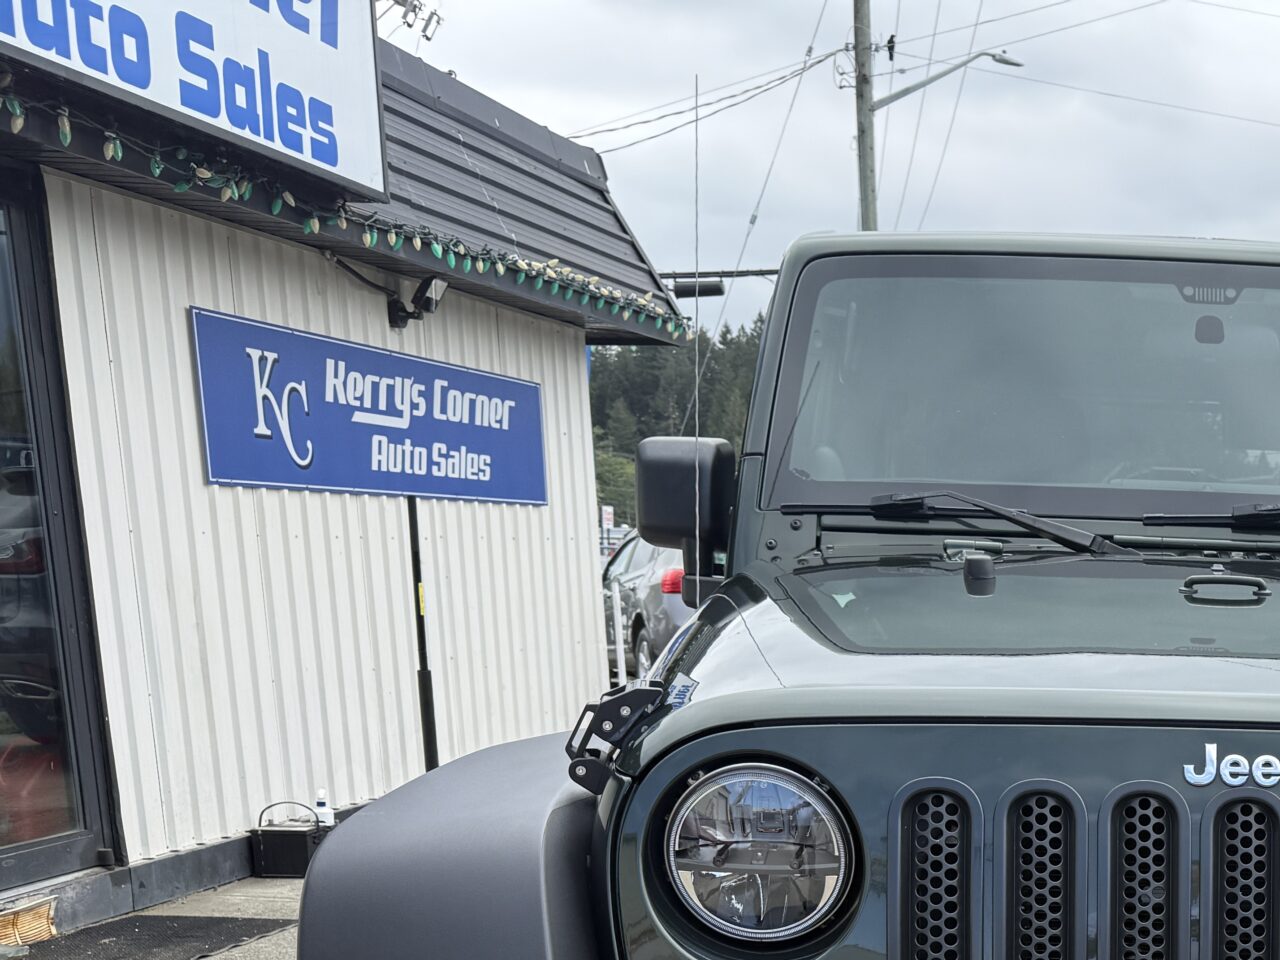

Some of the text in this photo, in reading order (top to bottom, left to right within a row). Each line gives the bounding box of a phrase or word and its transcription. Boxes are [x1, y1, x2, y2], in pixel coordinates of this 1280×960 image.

[0, 0, 339, 167] uto Sales
[325, 358, 516, 430] Kerry's Corner
[371, 434, 491, 481] Auto Sales
